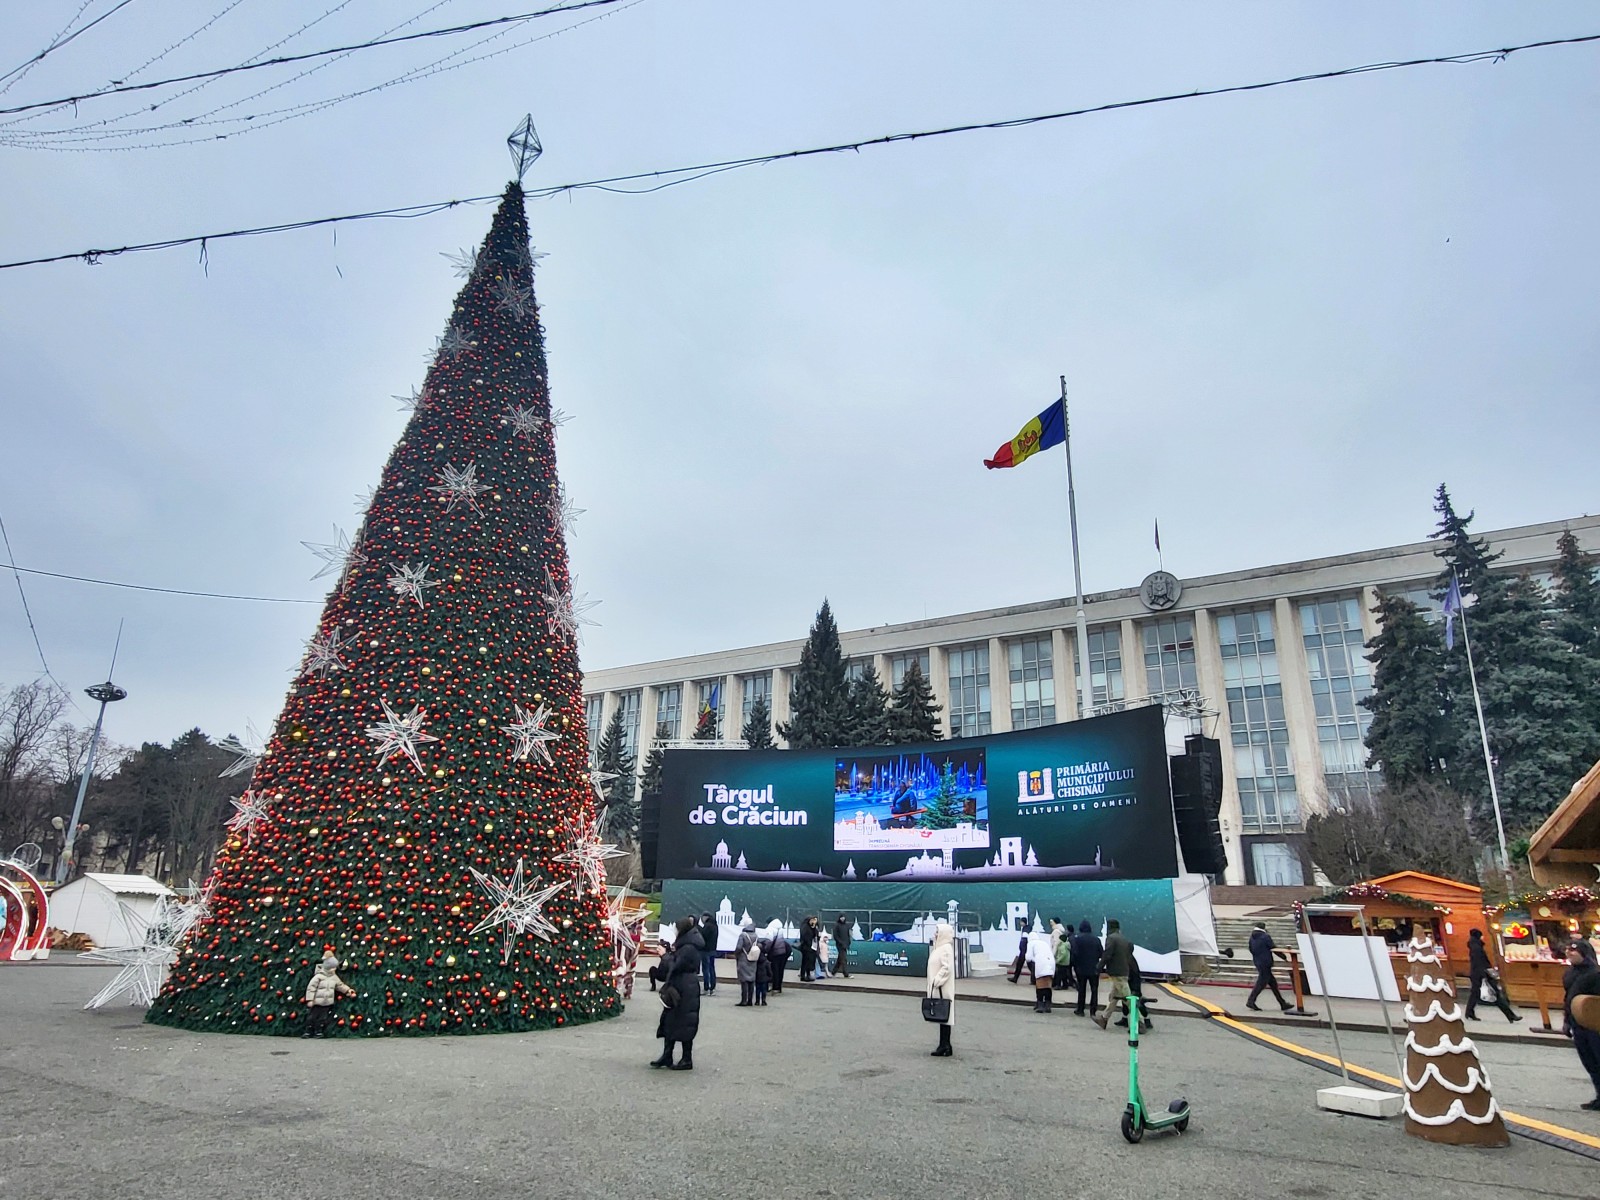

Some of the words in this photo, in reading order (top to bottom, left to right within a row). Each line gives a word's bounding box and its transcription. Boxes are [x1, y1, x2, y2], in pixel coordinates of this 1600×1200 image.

[1056, 761, 1110, 777] PRIMĂRIA
[1057, 768, 1135, 788] MUNICIPIULUI
[703, 784, 774, 808] Târgul
[1072, 803, 1086, 811] DE
[1093, 797, 1137, 808] OAMENI
[688, 805, 717, 824] de
[721, 805, 807, 825] Crăciun
[875, 958, 884, 966] de
